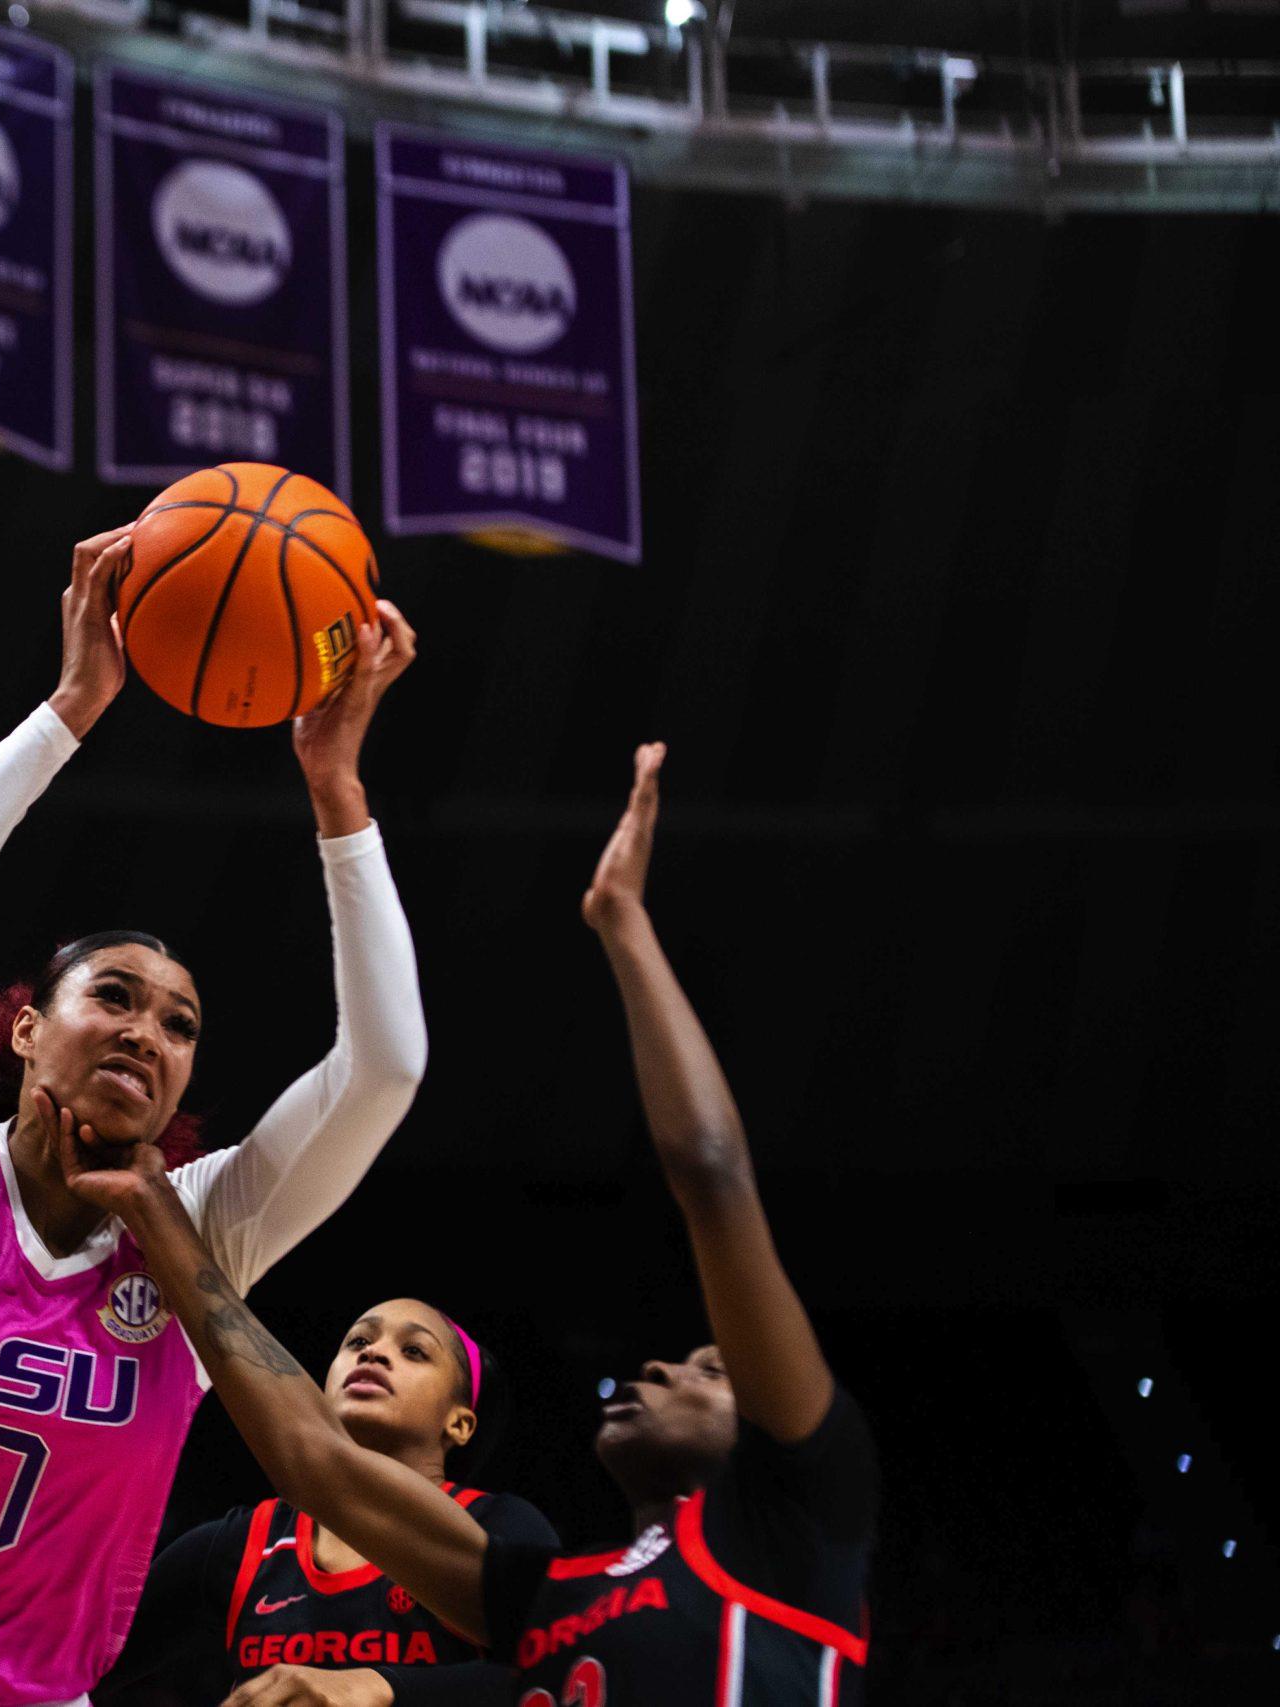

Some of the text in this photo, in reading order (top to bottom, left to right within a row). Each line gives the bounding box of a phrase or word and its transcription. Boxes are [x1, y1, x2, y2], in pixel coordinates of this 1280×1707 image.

[175, 217, 288, 268] NCAA
[457, 271, 573, 318] NCAA
[112, 1276, 160, 1326] SEC
[239, 1628, 439, 1669] GEORGIA
